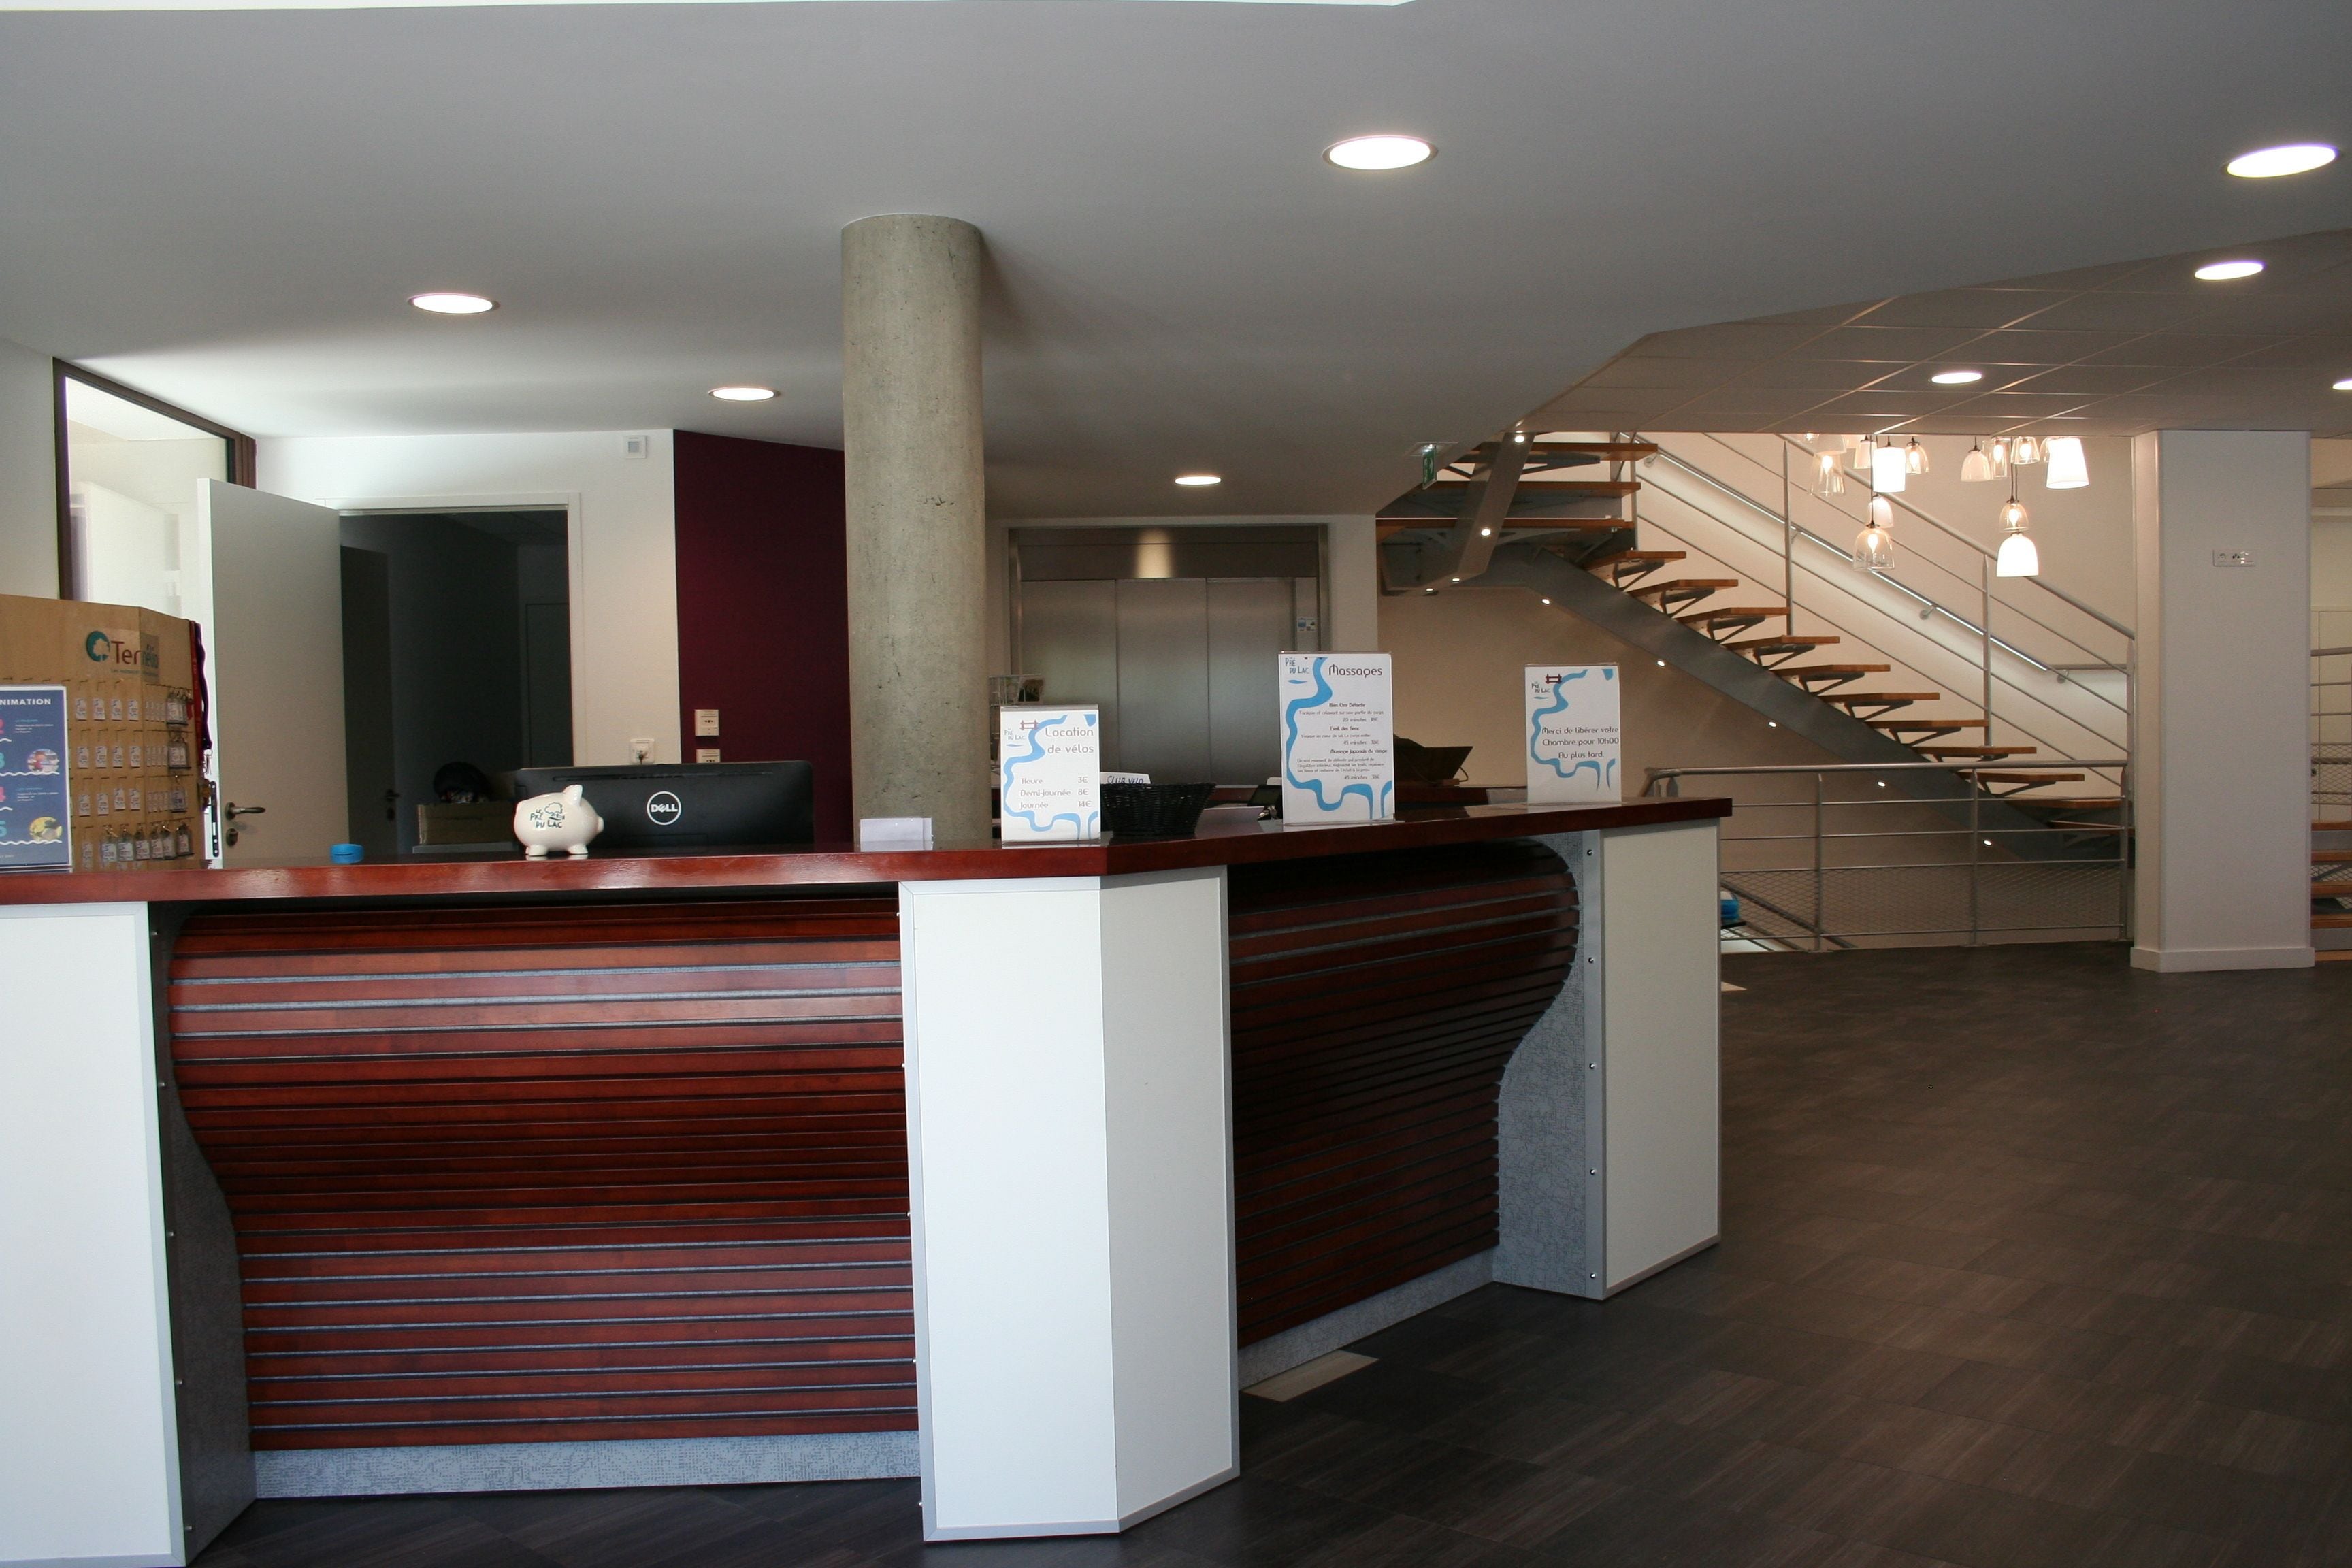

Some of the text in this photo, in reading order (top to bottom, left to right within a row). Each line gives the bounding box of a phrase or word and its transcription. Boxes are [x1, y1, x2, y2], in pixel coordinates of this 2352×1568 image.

[1297, 666, 1309, 674] LAC
[1328, 664, 1383, 678] Massages
[1045, 727, 1094, 737] Location
[1578, 739, 1595, 747] pour
[1047, 744, 1094, 753] de vélos
[1571, 751, 1586, 760] plus
[651, 804, 678, 813] DELL
[547, 820, 562, 828] LAC
